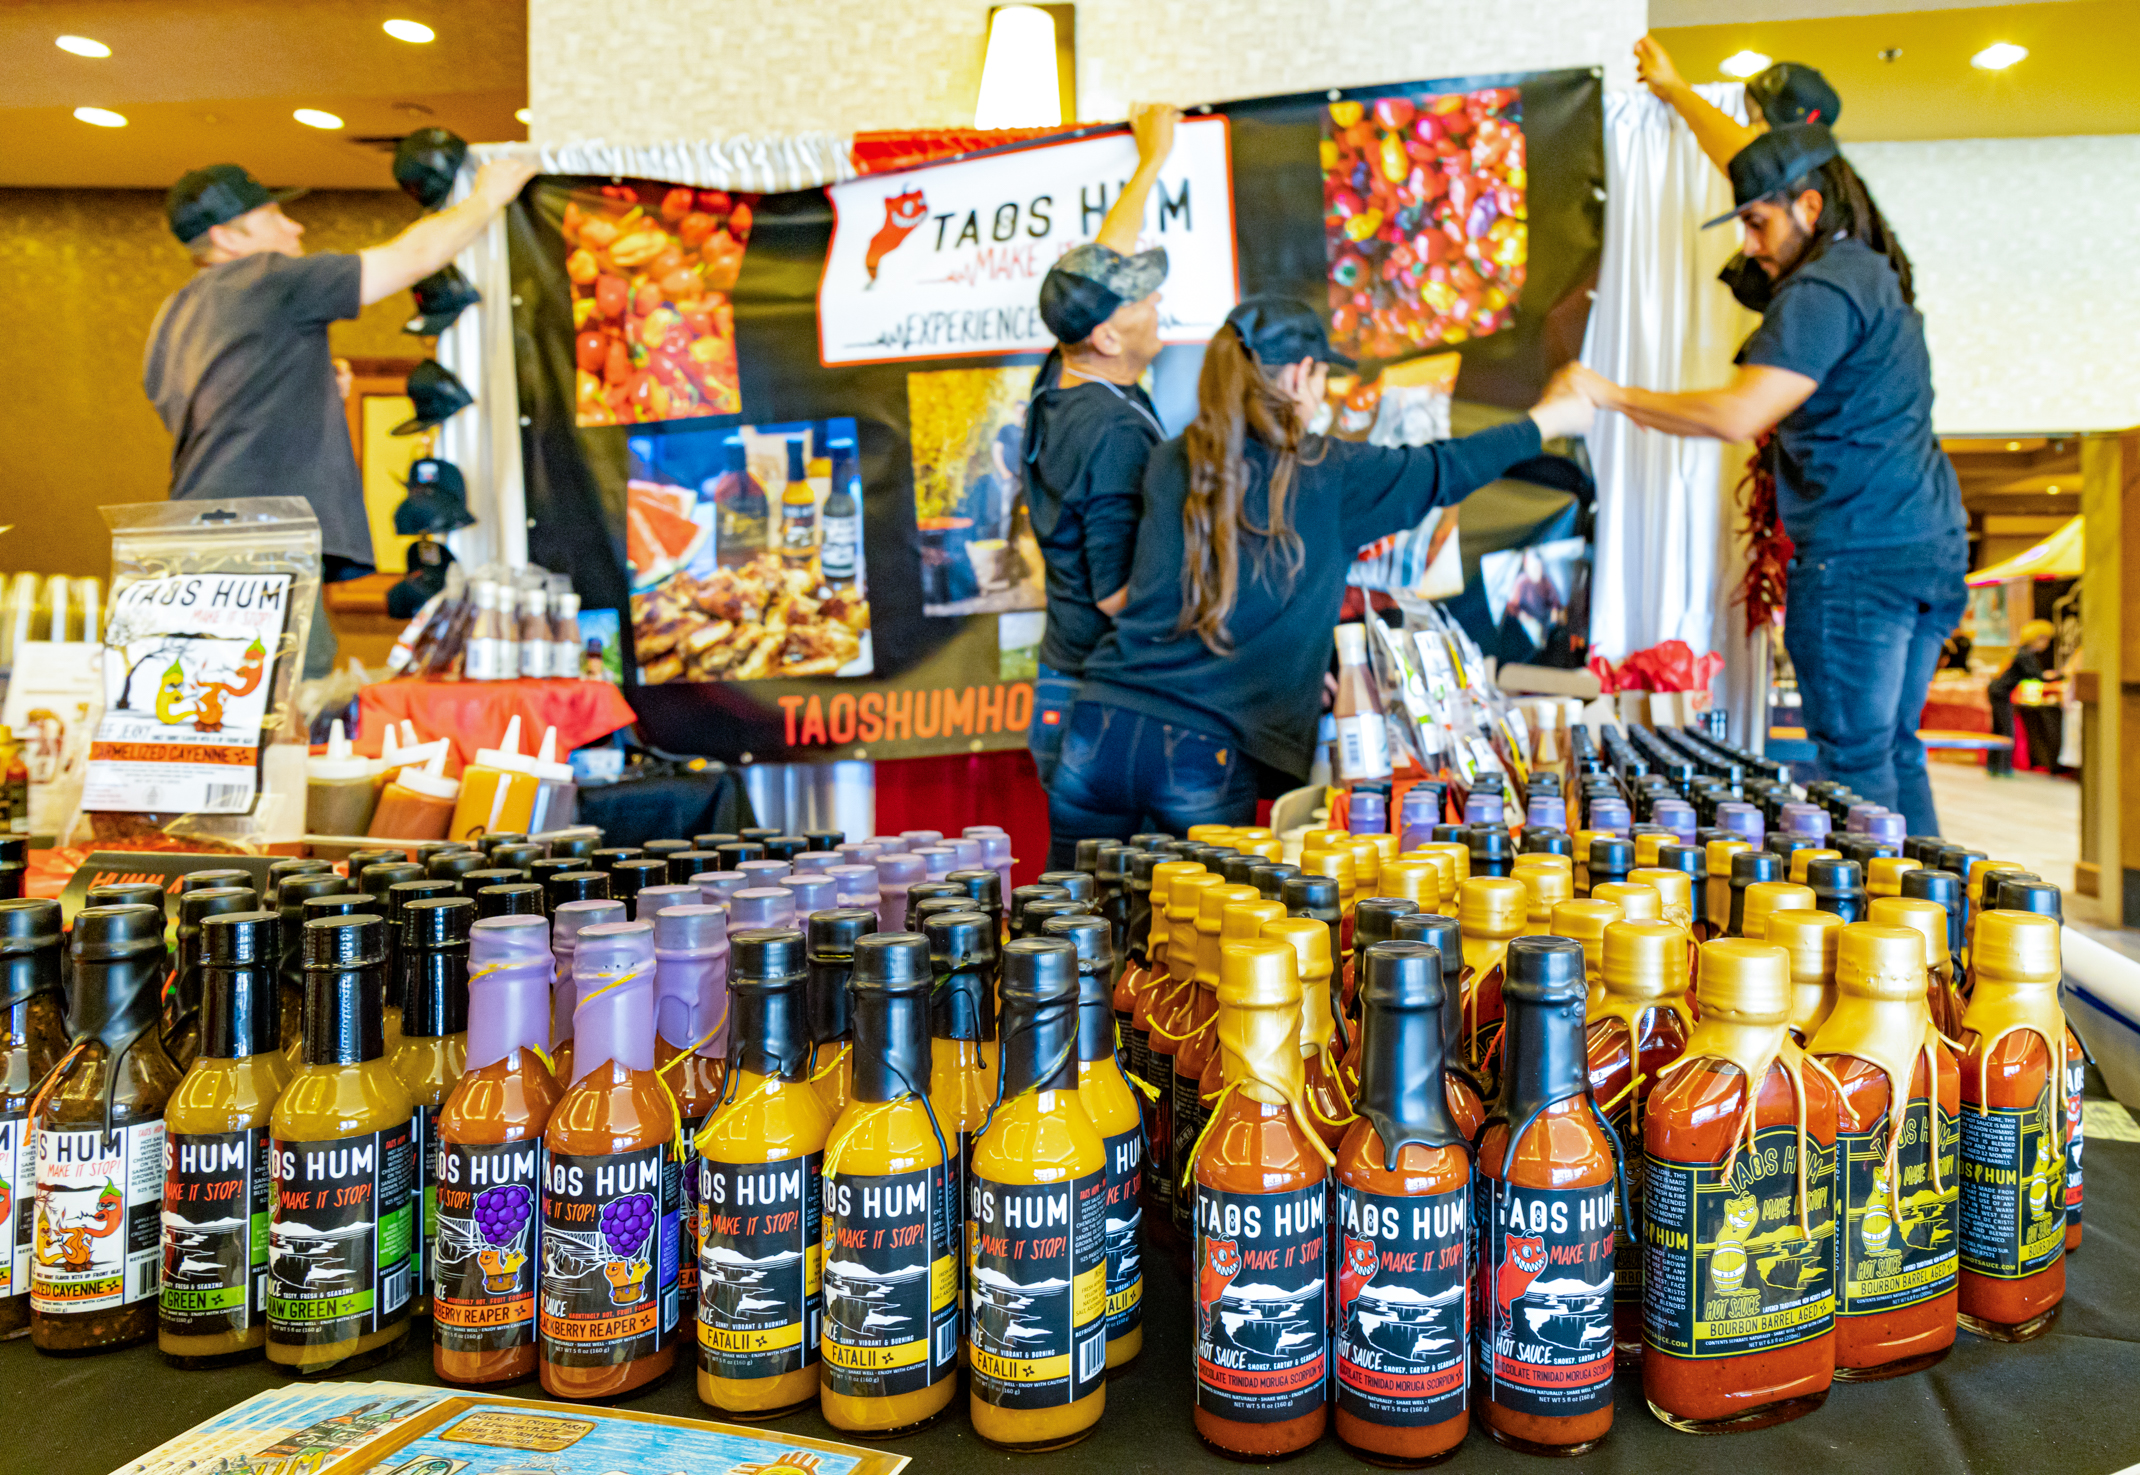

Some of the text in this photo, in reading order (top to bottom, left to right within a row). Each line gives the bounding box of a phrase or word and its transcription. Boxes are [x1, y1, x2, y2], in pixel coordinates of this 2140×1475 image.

[932, 176, 1192, 251] TAOS HM
[974, 241, 1040, 281] MAKE
[905, 307, 1041, 350] EXPERIENCE
[128, 580, 283, 610] TAOS HUM
[57, 1131, 122, 1162] HUM
[1973, 1142, 1986, 1150] AND
[1982, 1132, 1999, 1141] FRESH
[1991, 1140, 2016, 1148] BLENDED
[180, 1140, 245, 1174] HUM
[306, 1143, 374, 1181] HUM
[1782, 1145, 1824, 1185] HM
[1988, 1151, 2013, 1160] MONTHS
[47, 1159, 122, 1178] MAKE IT STOP!
[470, 1150, 535, 1185] HUM
[543, 1157, 584, 1197] AOS
[595, 1156, 659, 1197] HUM
[1984, 1167, 2017, 1186] HUM
[188, 1179, 244, 1201] IT STOP!
[736, 1168, 800, 1206] HUM
[1669, 1178, 1687, 1187] MADE
[1978, 1185, 1996, 1194] MADE
[281, 1182, 372, 1210] MAKE IT STOP!
[445, 1189, 471, 1210] STOP!
[863, 1180, 926, 1219] HUM
[1660, 1196, 1687, 1208] BLENDED
[553, 1201, 563, 1219] IT
[564, 1202, 597, 1222] STOP!
[1004, 1192, 1068, 1229] HUM
[1199, 1192, 1324, 1239] TAOS HUM
[1338, 1193, 1464, 1241] TAOS HUM
[1761, 1196, 1792, 1222] MAKE
[1981, 1210, 1998, 1219] WEST
[712, 1209, 800, 1237] MAKE IT STOP!
[1993, 1218, 2015, 1226] CRISTO
[836, 1223, 925, 1250] MAKE IT STOP!
[982, 1233, 1068, 1261] MAKE IT STOP!
[1656, 1226, 1689, 1252] HUM
[1243, 1236, 1324, 1271] MAKE IT STOP!
[1380, 1242, 1464, 1273] MAKE IT STOP!
[1549, 1243, 1586, 1266] MAKE
[1588, 1240, 1600, 1263] IT
[1856, 1259, 1877, 1281] HOT
[1876, 1254, 1903, 1278] SAUCE
[53, 1281, 105, 1298] CAYENNE
[197, 1281, 223, 1290] SEARING
[1860, 1279, 1901, 1296] BOURBON
[1902, 1271, 1929, 1288] BARREL
[1930, 1263, 1946, 1280] AGED
[167, 1291, 207, 1309] GREEN
[300, 1287, 354, 1300] FRESH SEARING
[1663, 1286, 1687, 1297] CRISTO
[289, 1299, 338, 1319] GREEN
[464, 1306, 510, 1323] REAPER
[544, 1295, 568, 1317] SAUCE
[617, 1307, 633, 1316] FRUIT
[1704, 1297, 1727, 1322] HOT
[1727, 1294, 1762, 1319] SAUCE
[589, 1317, 637, 1338] REAPER
[732, 1318, 788, 1331] VIBRANT BURNING
[1710, 1318, 1759, 1338] BOURBON
[1761, 1310, 1796, 1333] BARREL
[1797, 1304, 1819, 1322] AGED
[707, 1328, 750, 1350] FATALII
[858, 1334, 914, 1347] VIBRANT BURNING
[1495, 1335, 1516, 1358] HOT
[1516, 1342, 1554, 1365] SAUCE
[832, 1344, 876, 1367] FATALII
[977, 1351, 1017, 1378] FATALII
[1000, 1348, 1056, 1359] VIBRANT BURNING
[1199, 1339, 1248, 1370] HOT SAUCE
[1273, 1350, 1318, 1371] EARTHY SEARING
[1338, 1337, 1384, 1371] HOT SAUCE
[1578, 1352, 1596, 1364] EARTHY
[1227, 1365, 1317, 1389] TRINIDAD MORUGA SCORPION
[1409, 1358, 1456, 1374] EARTHY SEARING
[1494, 1358, 1592, 1383] CHOCOLATE TRINIDAD MORUGA
[1364, 1373, 1456, 1392] TRINIDAD MORUGA SCORPION
[1514, 1384, 1536, 1395] SEPARATE
[1536, 1389, 1563, 1397] NATURALLY
